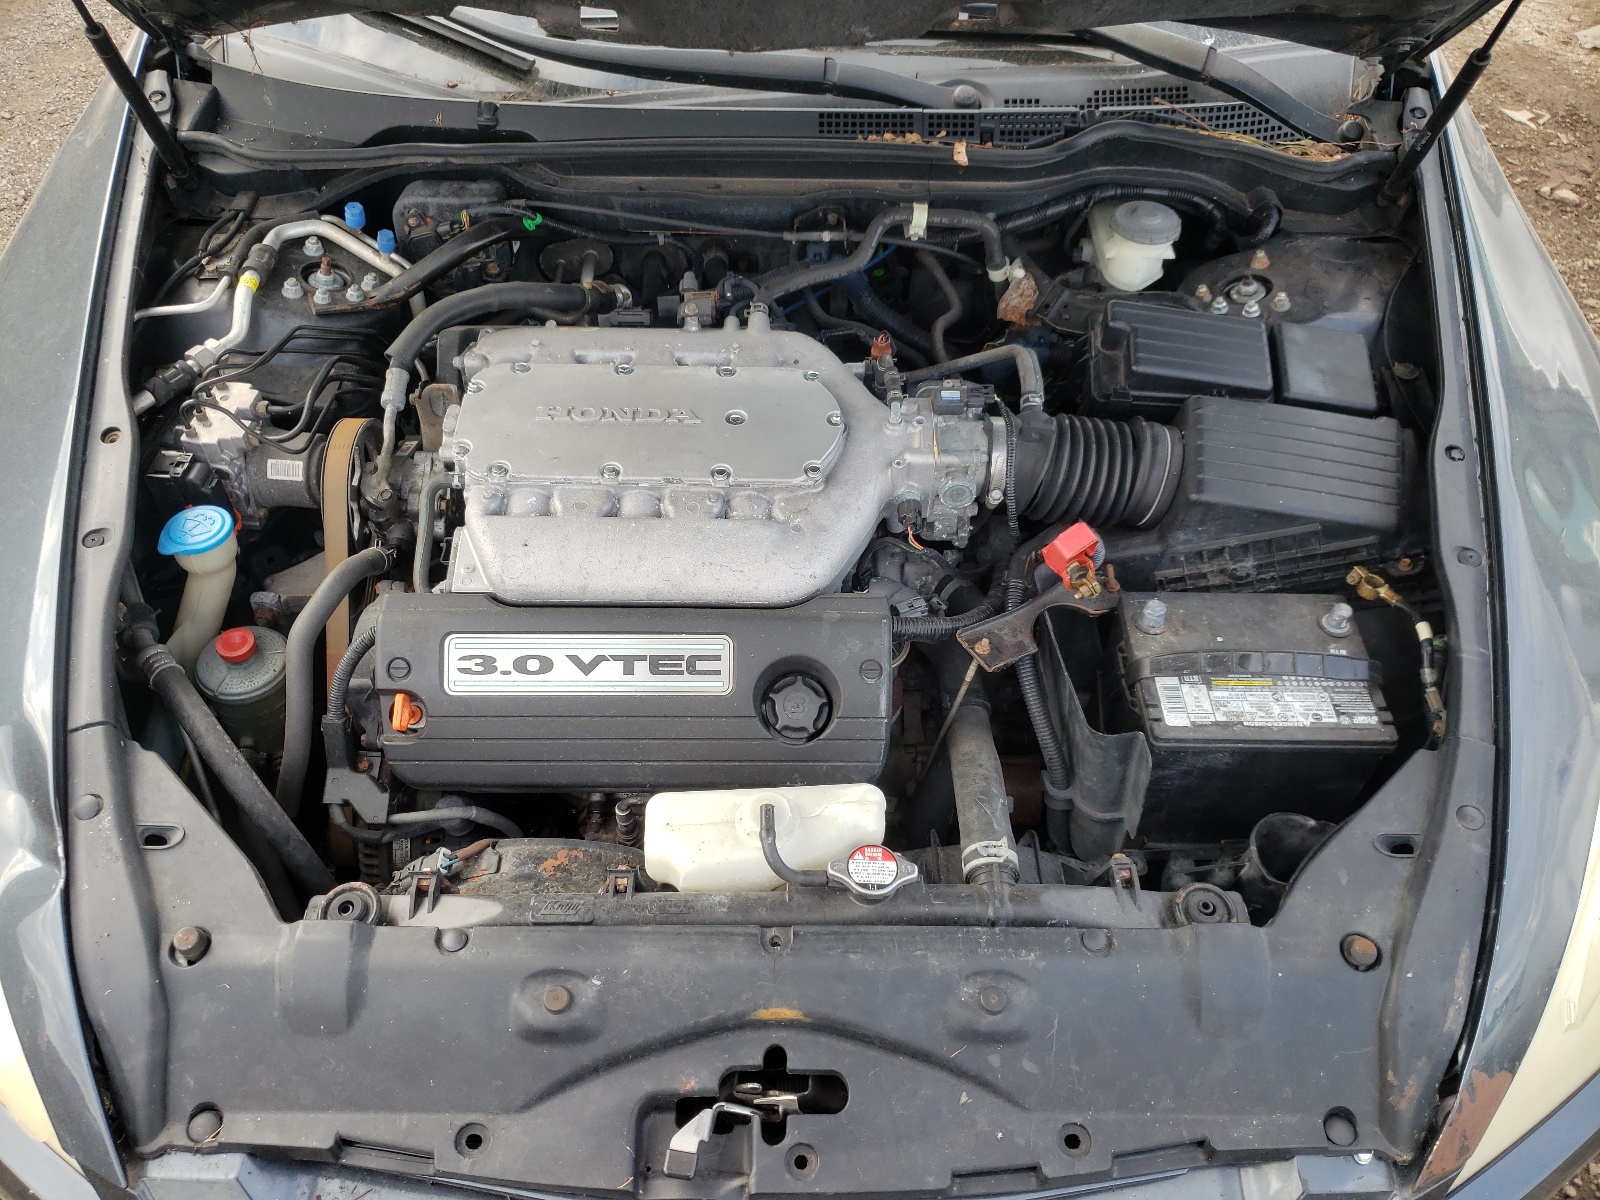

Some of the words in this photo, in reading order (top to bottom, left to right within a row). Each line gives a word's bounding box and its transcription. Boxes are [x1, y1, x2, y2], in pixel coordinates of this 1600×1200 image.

[535, 405, 703, 424] HONDA
[456, 654, 555, 676] 3.0
[564, 654, 722, 677] VTEC
